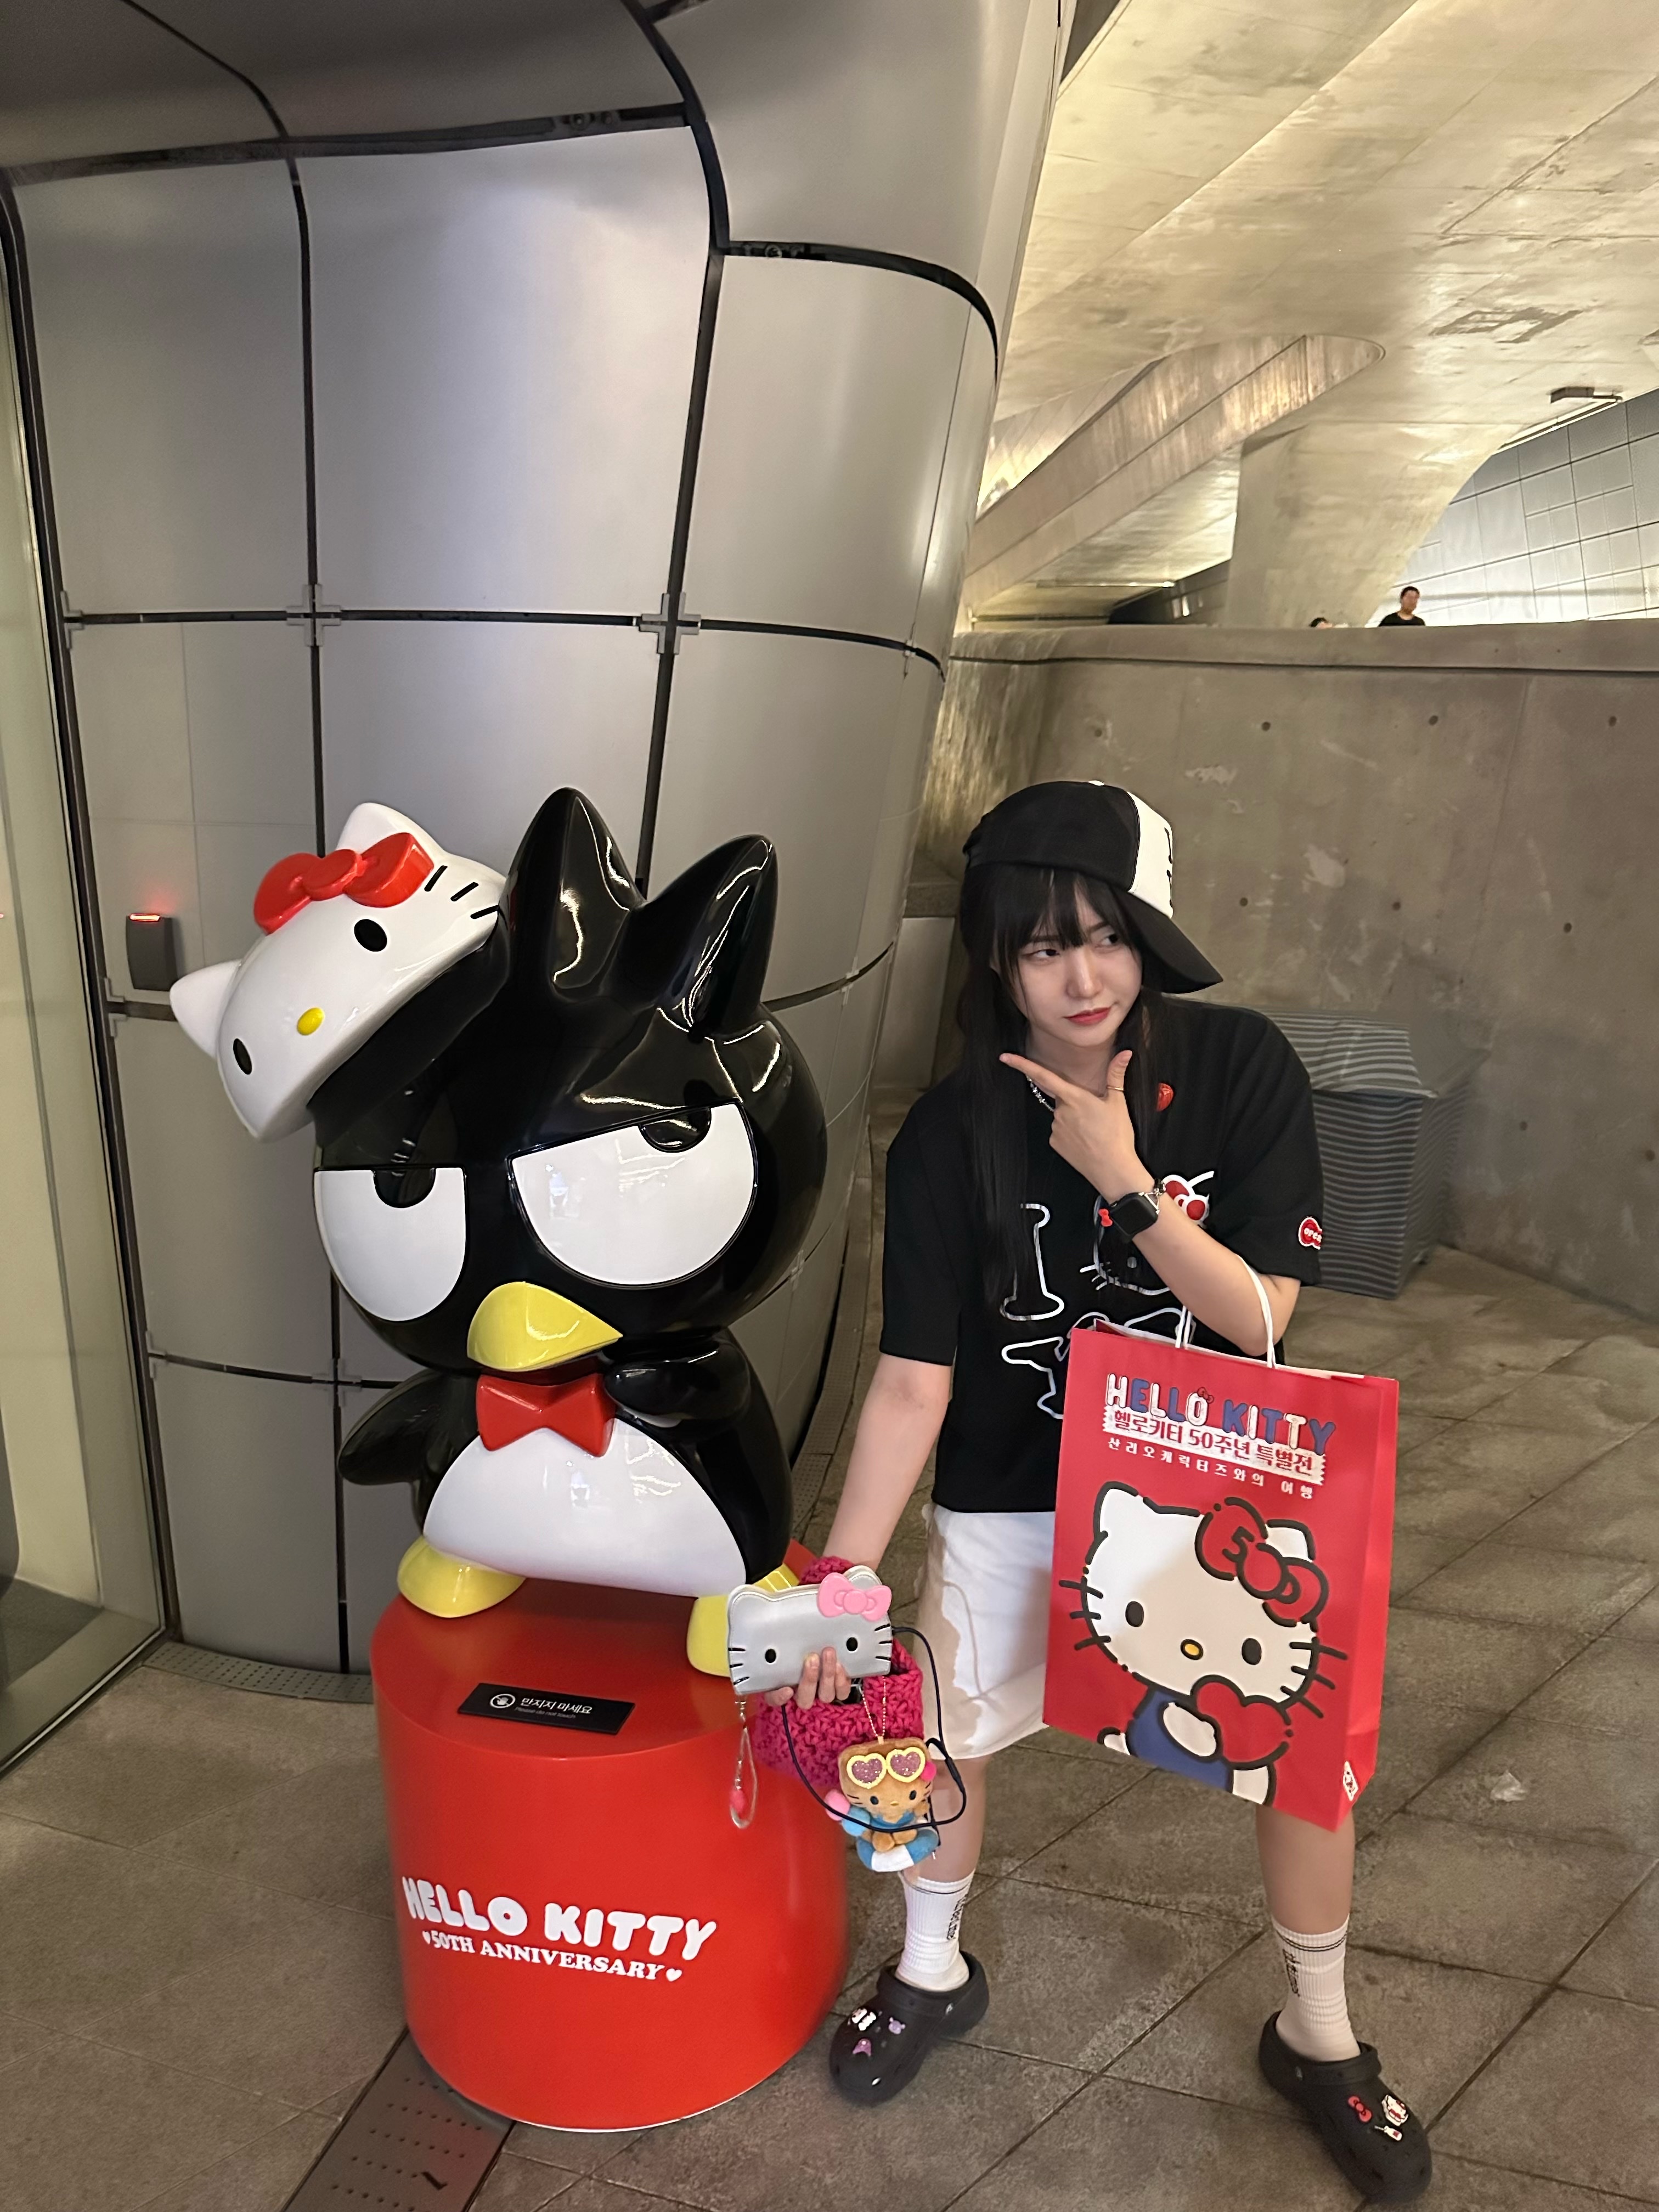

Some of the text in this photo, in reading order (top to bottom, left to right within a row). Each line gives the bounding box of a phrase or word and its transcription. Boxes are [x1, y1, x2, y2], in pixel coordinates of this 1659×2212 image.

[1105, 1373, 1208, 1426] HELLO
[1222, 1400, 1336, 1455] KITTY
[1114, 1410, 1313, 1476] 헬로키티 50주년 특별전
[521, 1697, 592, 1714] 만지지 마세요
[402, 1876, 717, 1961] HELLO KITTY
[431, 1929, 665, 1980] 50TH ANNIVERSARY
